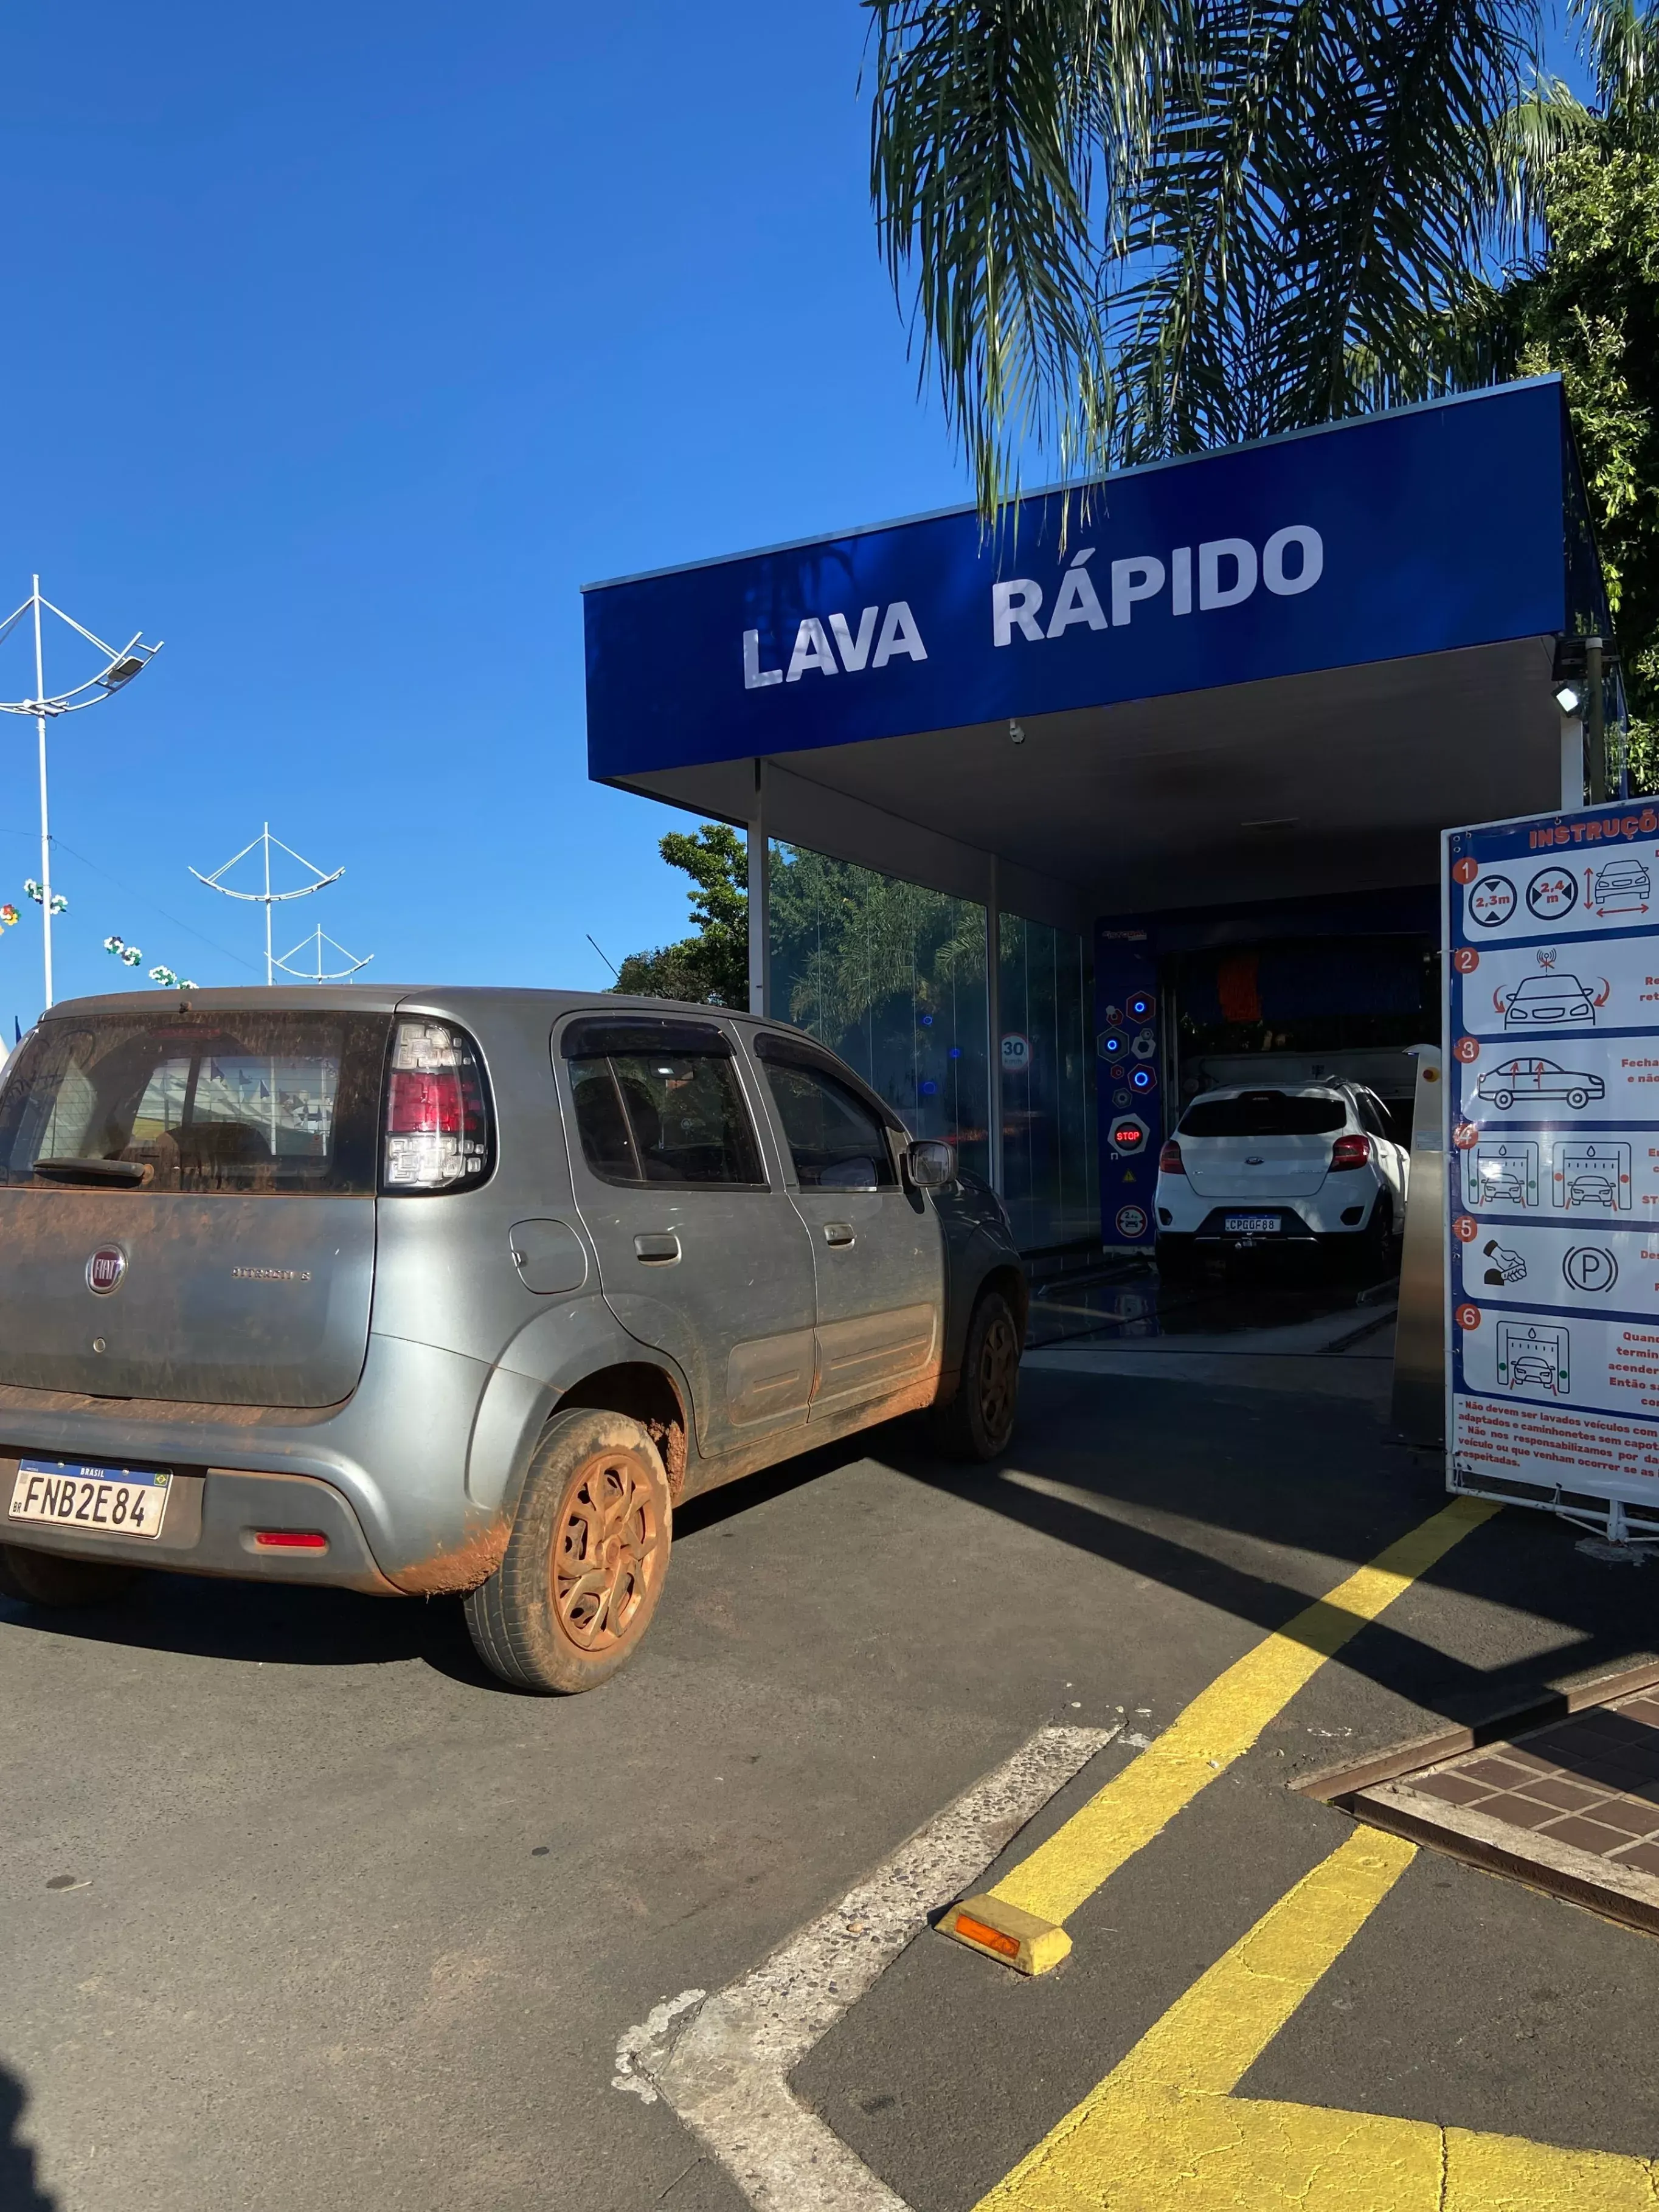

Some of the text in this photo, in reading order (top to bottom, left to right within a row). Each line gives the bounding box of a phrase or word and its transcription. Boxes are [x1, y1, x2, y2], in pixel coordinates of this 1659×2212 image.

[743, 525, 1324, 690] LAVA RÁPIDO
[1529, 809, 1659, 849] INSTRUÇÕ
[1462, 862, 1469, 879] 1
[1540, 880, 1564, 893] 2,4
[1475, 895, 1510, 908] 2,3m
[1546, 894, 1559, 904] m
[1461, 952, 1472, 969] 2
[1003, 1042, 1024, 1056] 30
[1462, 1041, 1473, 1058] 3
[1117, 1132, 1140, 1141] STOP
[1460, 1127, 1472, 1144] 4
[1642, 1195, 1659, 1204] ST
[1461, 1220, 1471, 1237] 5
[94, 1259, 117, 1279] FIAT
[1463, 1308, 1475, 1325] 6
[1609, 1377, 1646, 1389] Então
[1466, 1400, 1484, 1411] Não
[1486, 1404, 1519, 1417] devem
[1521, 1411, 1538, 1419] ser
[1540, 1412, 1581, 1426] lavados
[1584, 1420, 1630, 1434] veículos
[1633, 1428, 1658, 1437] com
[1458, 1413, 1511, 1428] adaptados
[1521, 1425, 1596, 1441] caminhonetes
[1598, 1436, 1621, 1446] sem
[1468, 1425, 1486, 1436] Não
[1491, 1431, 1509, 1440] nos
[1514, 1435, 1613, 1457] responsabilizamos
[1618, 1452, 1638, 1461] por
[1458, 1437, 1494, 1450] veículo
[1496, 1444, 1509, 1453] ou
[1511, 1447, 1530, 1456] que
[1533, 1450, 1575, 1464] venham
[1578, 1459, 1621, 1471] ocorrer
[1641, 1468, 1654, 1477] as
[80, 1467, 105, 1478] BRASIL
[13, 1501, 22, 1514] BR
[23, 1476, 147, 1527] FNB2E84
